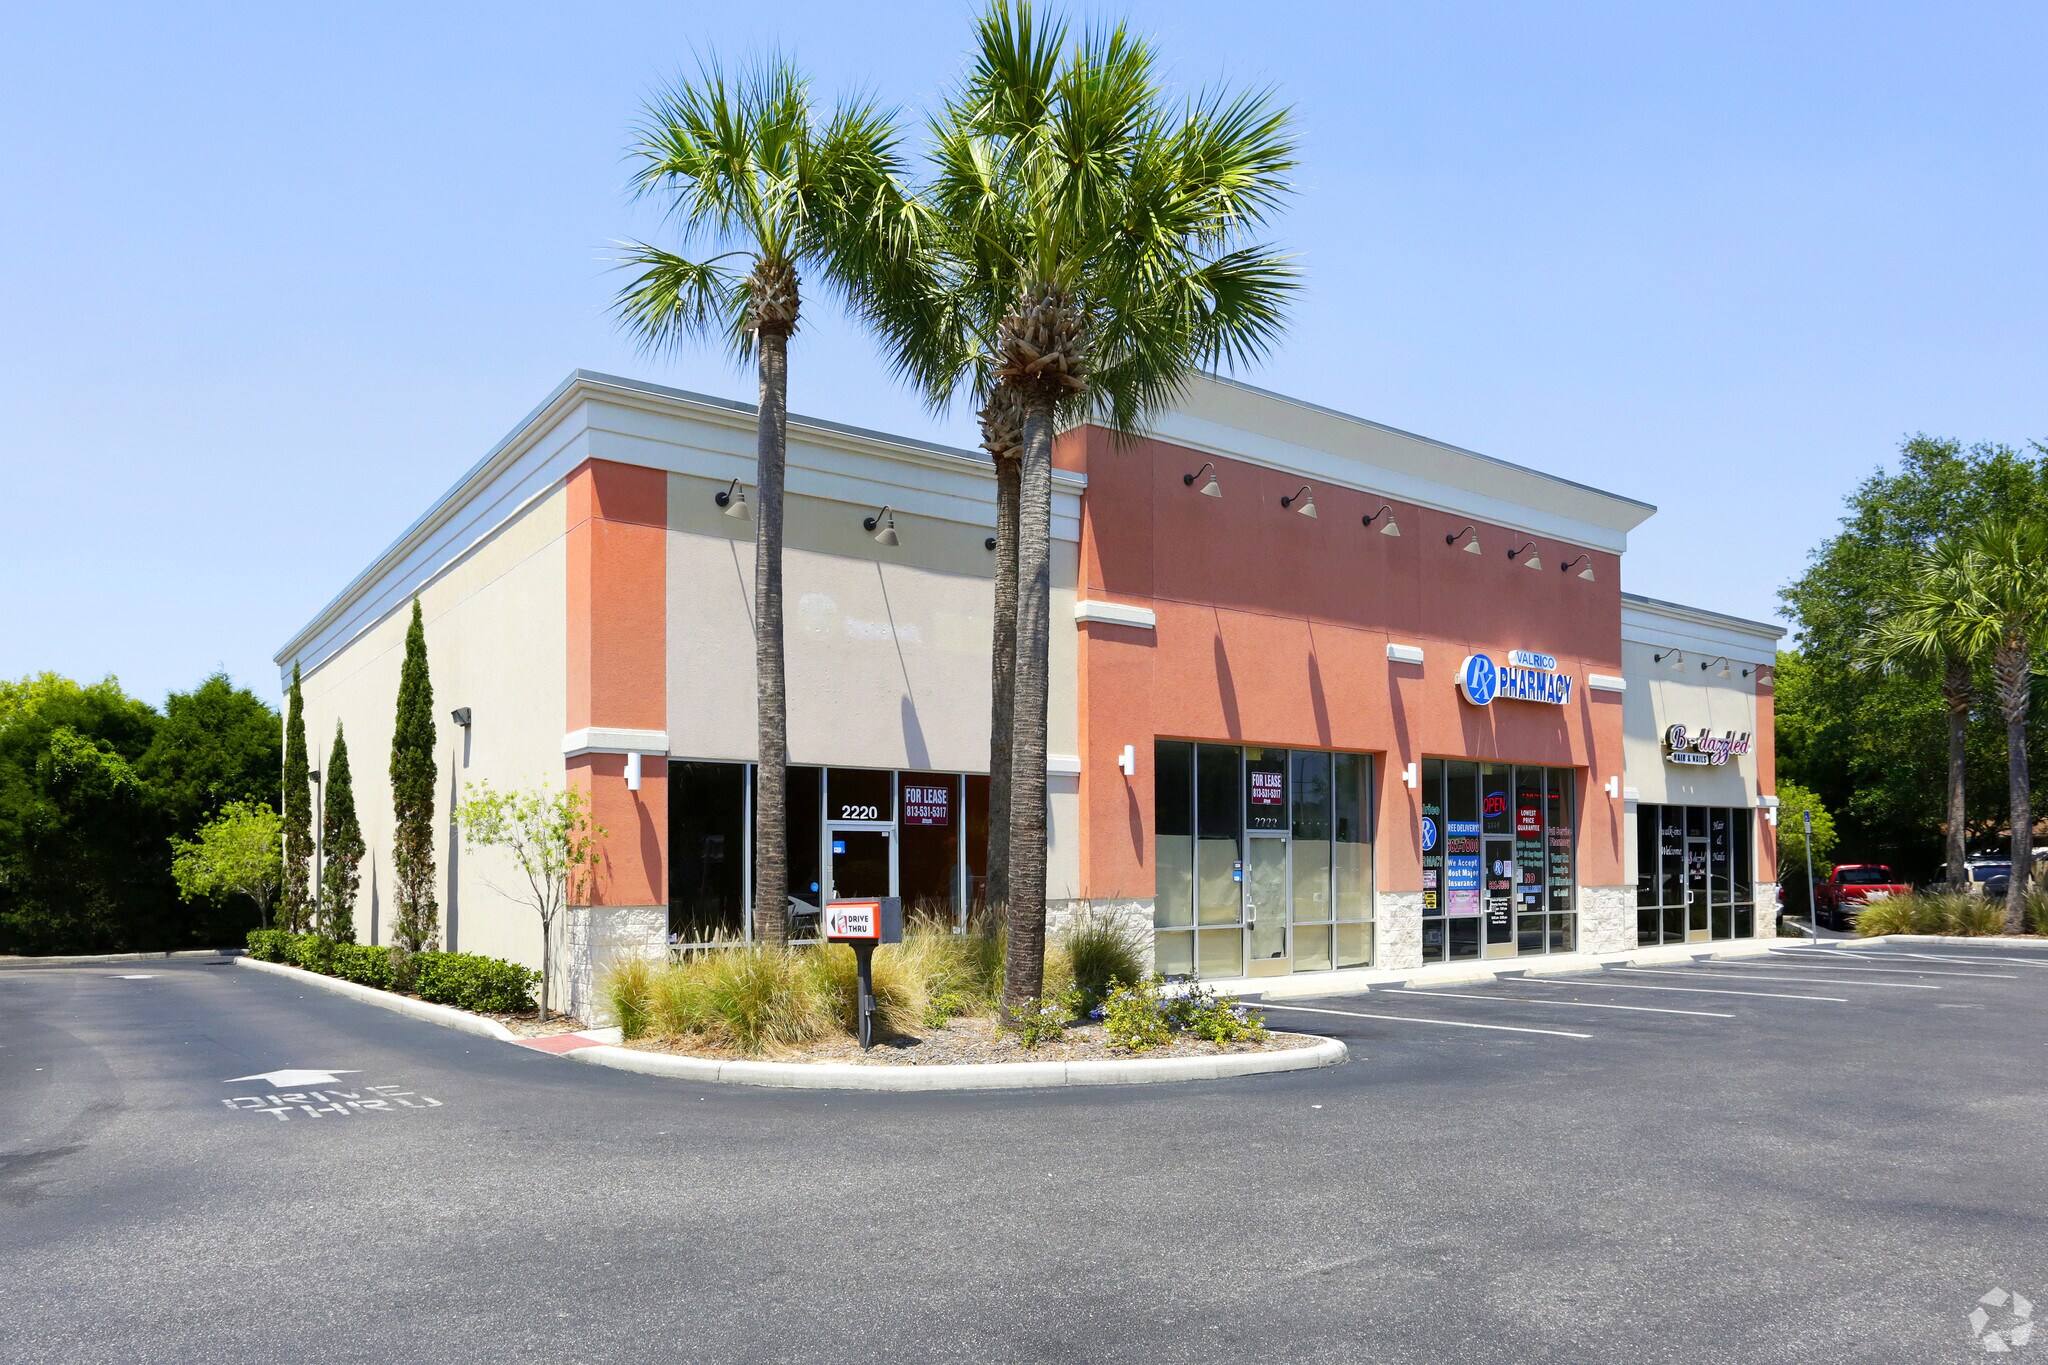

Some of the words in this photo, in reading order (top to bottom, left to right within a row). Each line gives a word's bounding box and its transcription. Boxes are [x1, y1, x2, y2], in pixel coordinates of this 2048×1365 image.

[1516, 651, 1555, 669] VALRICO
[1500, 667, 1572, 703] PHARMACY
[1674, 753, 1686, 761] HAIR
[1693, 754, 1707, 763] NAILS
[1252, 774, 1263, 786] FOR
[1265, 775, 1281, 787] LEASE
[906, 788, 921, 803] FOR
[924, 788, 947, 804] LEASE
[1253, 788, 1281, 798] 813-531-5317
[1483, 796, 1506, 812] OPEN
[842, 805, 878, 819] 2220
[906, 805, 947, 817] 813-531-5317
[1448, 824, 1457, 832] REE
[1458, 860, 1477, 868] Accept
[1462, 869, 1479, 878] Major
[1525, 873, 1536, 883] NO
[221, 1084, 415, 1111] DRIVE
[253, 1095, 443, 1121] THRU
